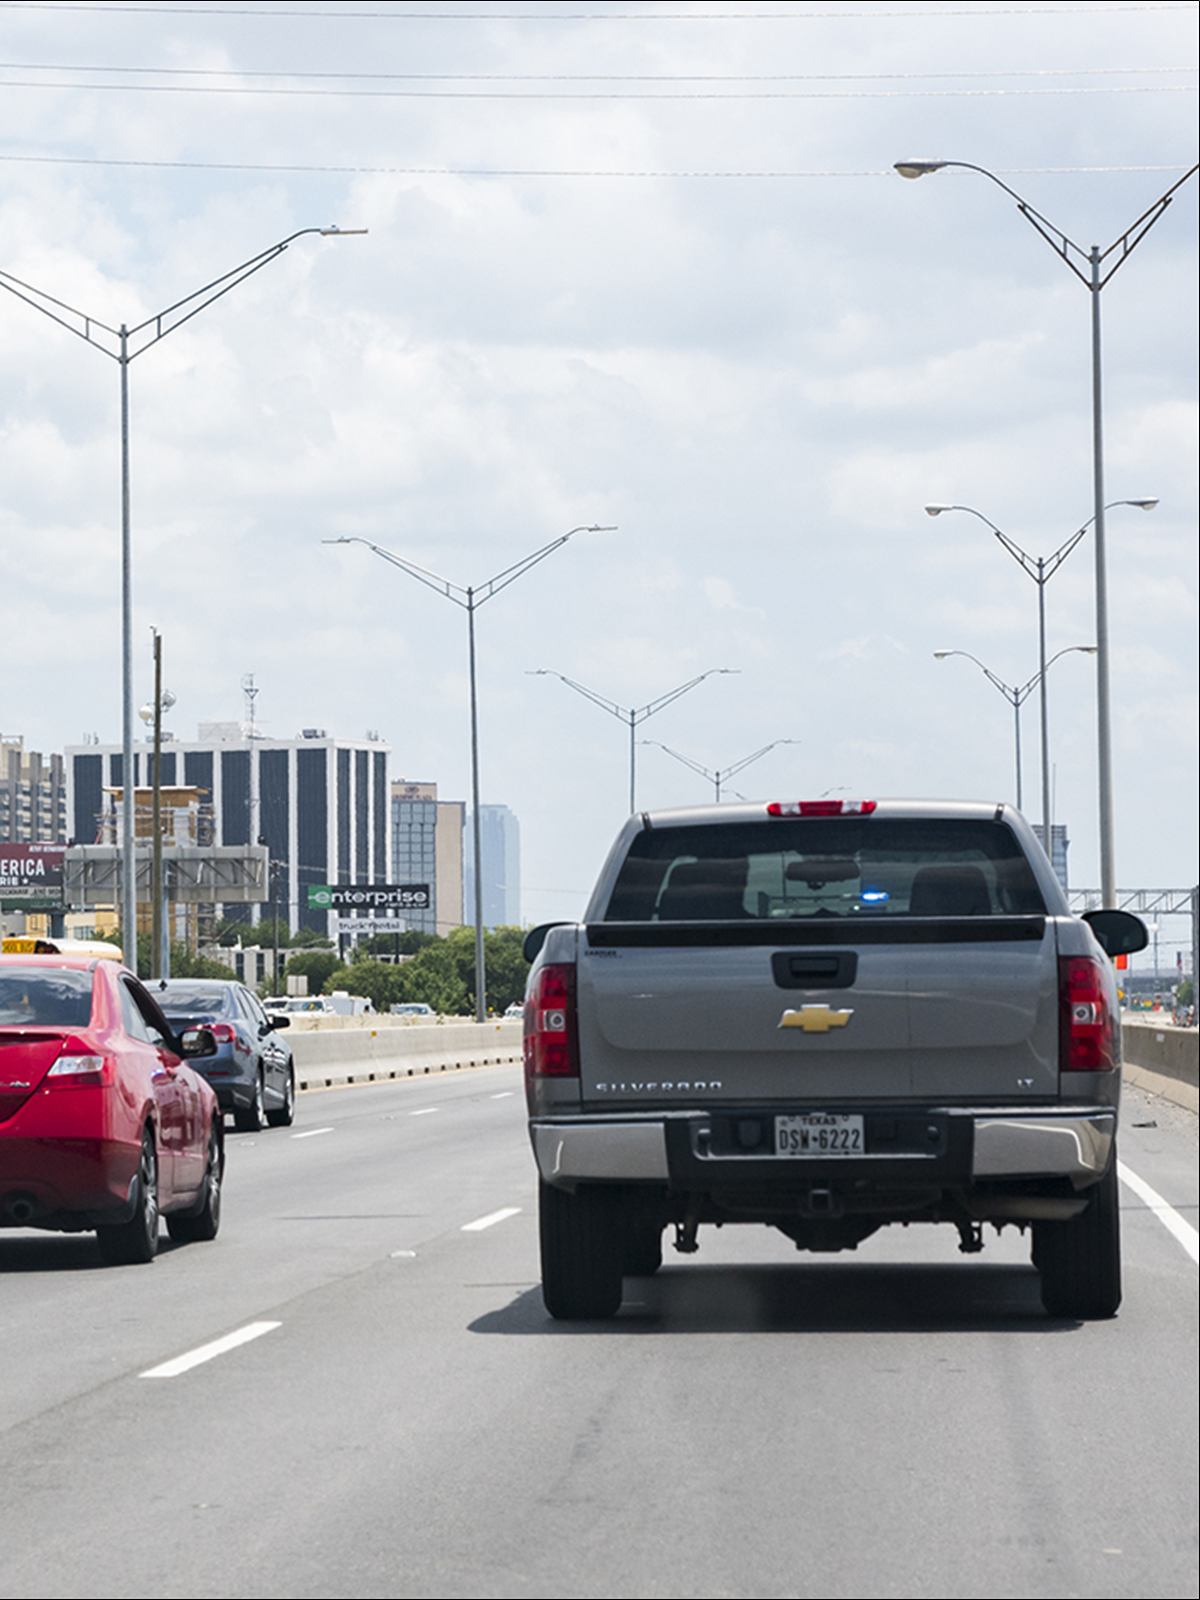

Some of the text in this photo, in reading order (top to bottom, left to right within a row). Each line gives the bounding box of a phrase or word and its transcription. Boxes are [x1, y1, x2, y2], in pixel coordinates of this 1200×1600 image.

[308, 889, 427, 906] enterprise
[596, 1081, 722, 1093] SILVERADO
[1017, 1078, 1034, 1089] LT
[801, 1116, 836, 1126] TEXAS
